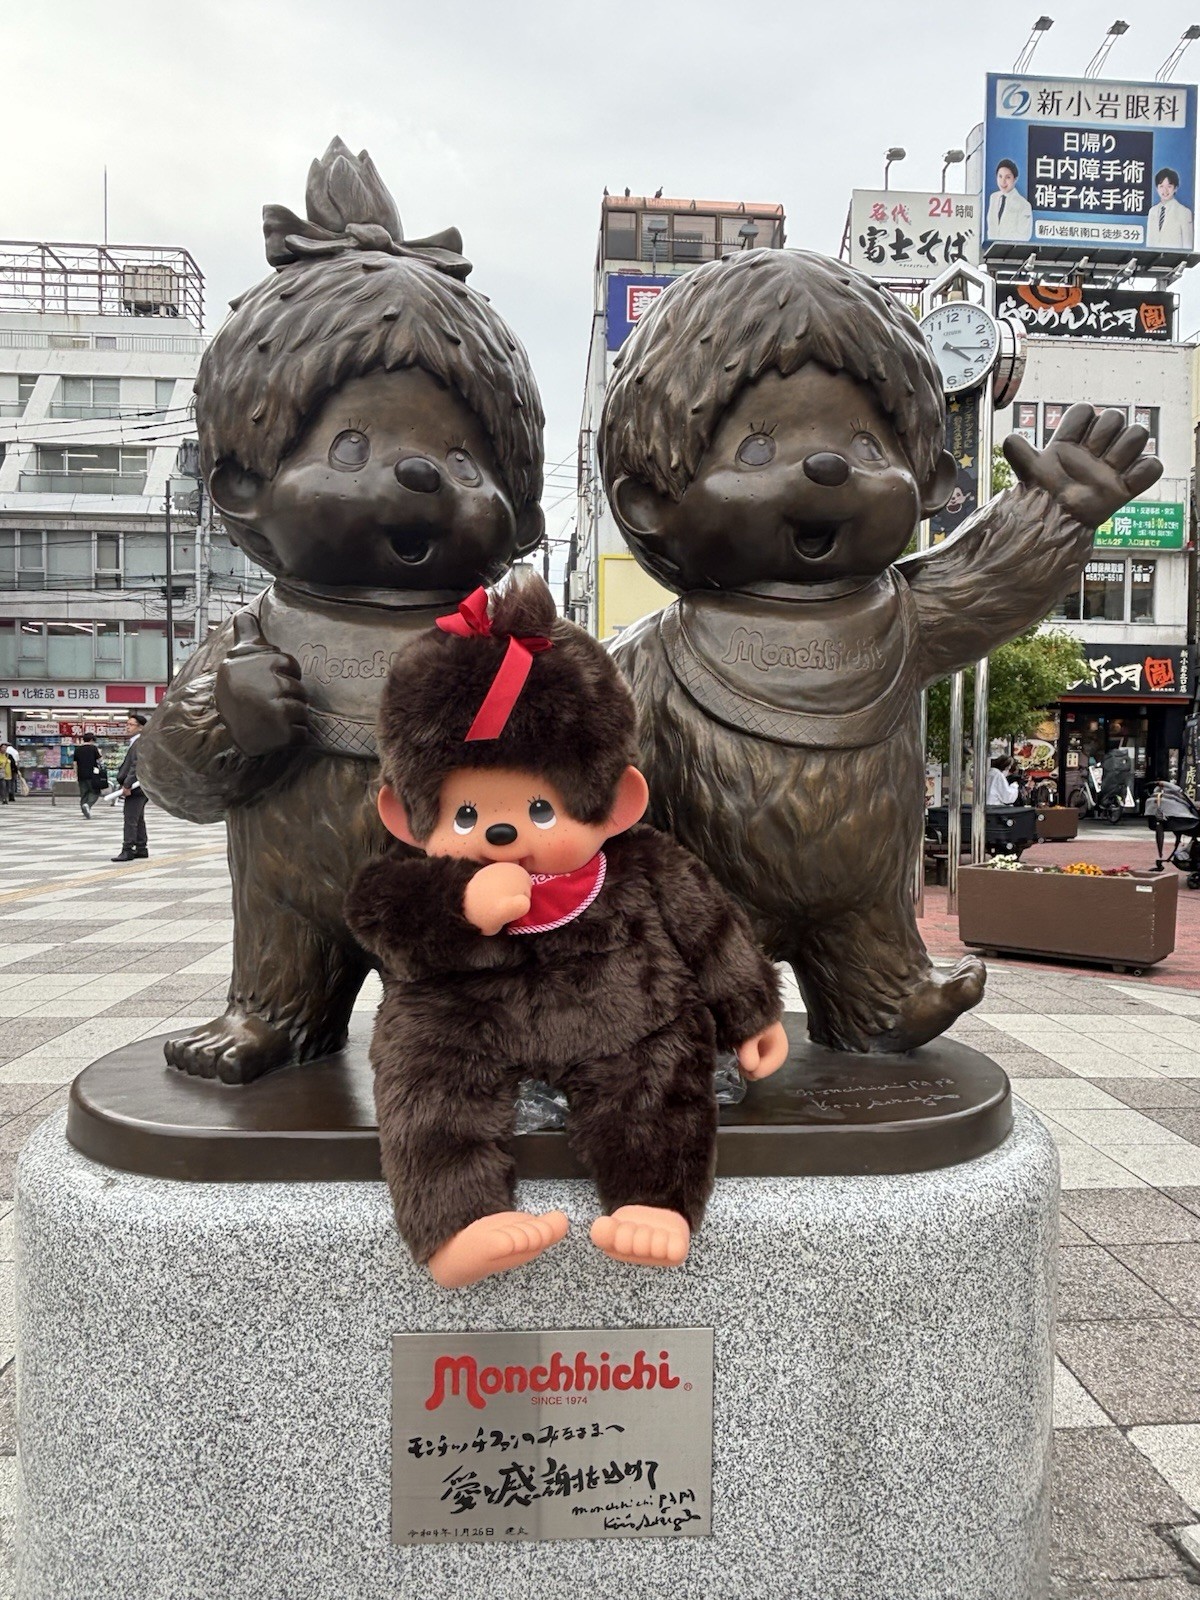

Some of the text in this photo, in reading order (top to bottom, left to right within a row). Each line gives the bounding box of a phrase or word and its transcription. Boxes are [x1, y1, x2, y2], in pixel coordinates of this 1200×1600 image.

[1036, 87, 1180, 123] 新小岩眼科
[1062, 132, 1117, 154] 日帰り
[1035, 156, 1146, 184] 白内障手術
[1034, 184, 1146, 213] 硝子体手術
[869, 202, 911, 224] 名代
[928, 197, 974, 219] 24 時間
[858, 226, 974, 264] 富士そば
[930, 321, 942, 332] 11
[946, 312, 960, 324] 12
[967, 314, 971, 324] 1
[975, 324, 986, 335] 2
[974, 354, 986, 363] 4
[946, 375, 957, 385] 6
[963, 368, 974, 378] 5
[722, 626, 887, 672] Monchhichi
[22, 688, 55, 699] 化粧品
[67, 688, 100, 700] 日用品
[425, 1350, 681, 1411] Monchhichi
[530, 1395, 589, 1406] SINCE 1974
